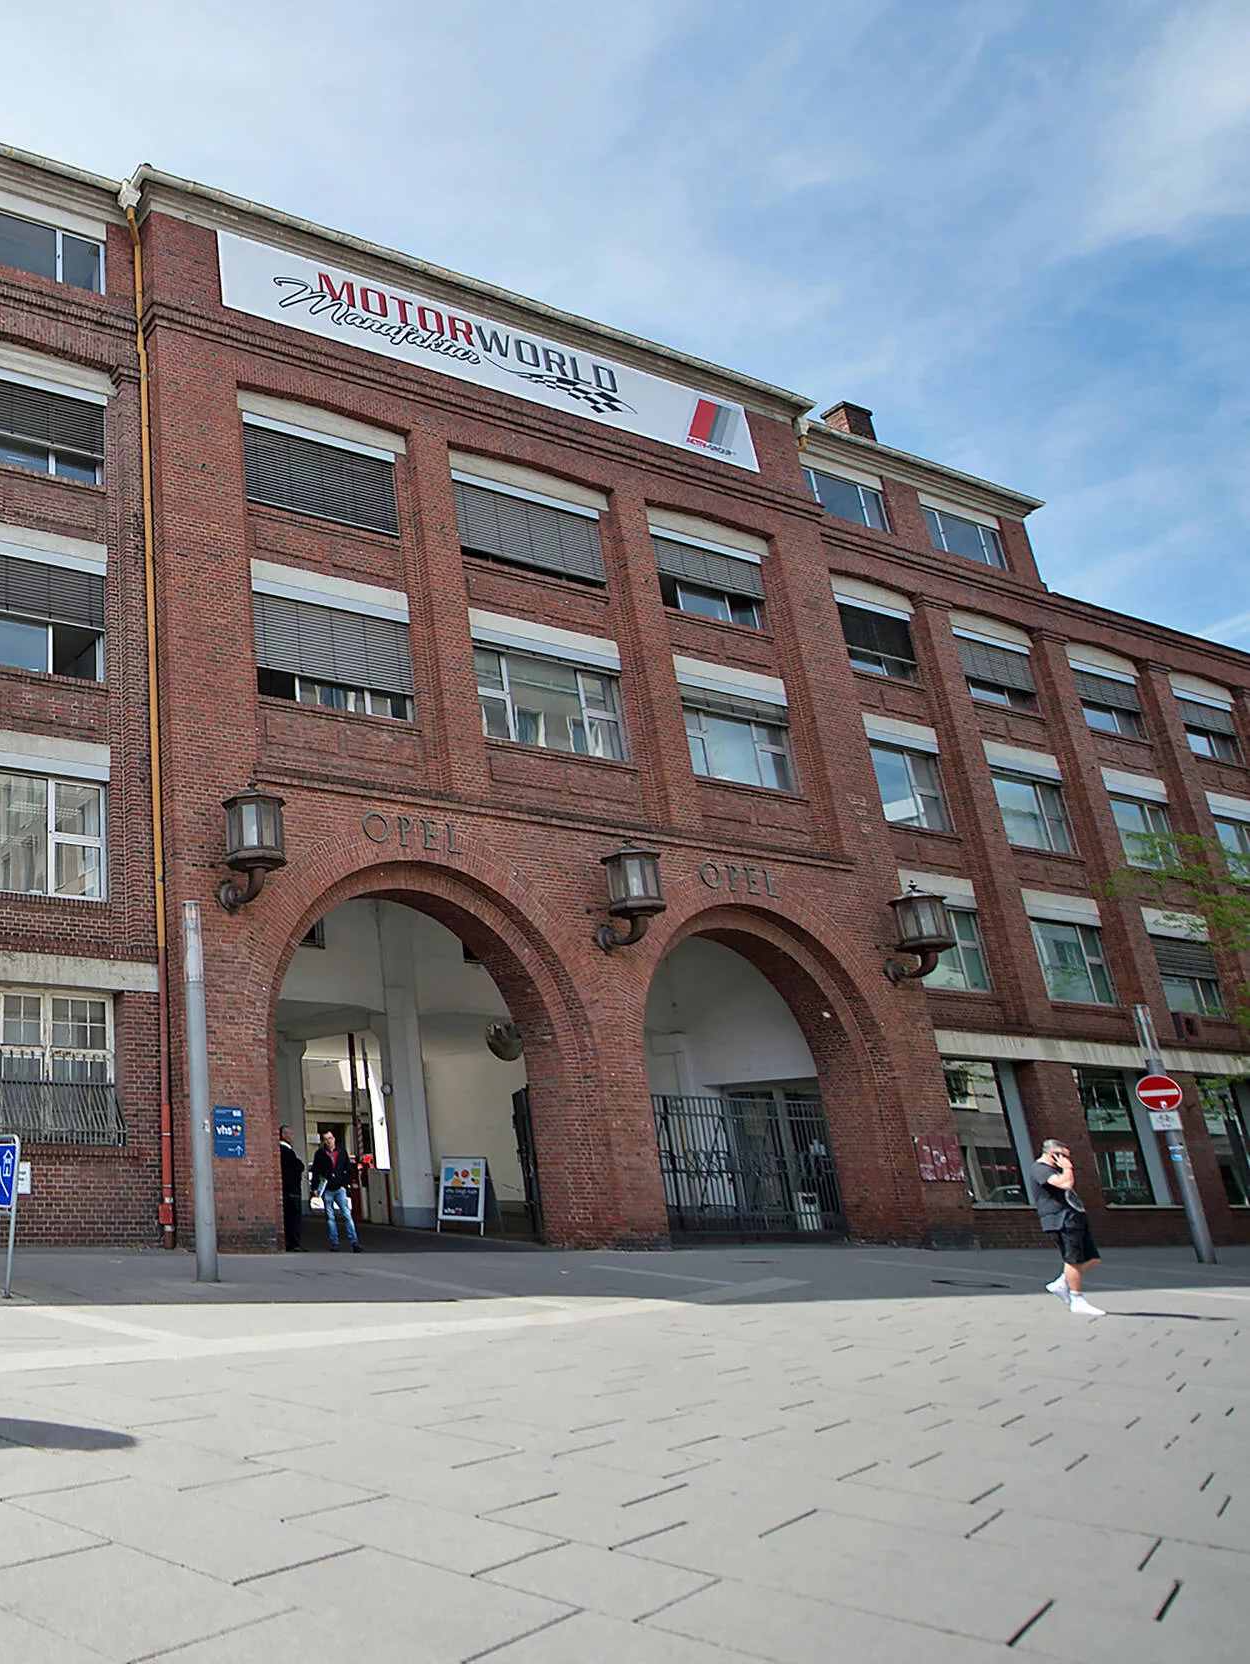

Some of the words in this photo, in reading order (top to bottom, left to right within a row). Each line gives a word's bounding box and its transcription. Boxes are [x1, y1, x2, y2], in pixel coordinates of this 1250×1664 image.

[273, 276, 481, 365] Manufaktur
[318, 271, 618, 393] MOTORWORLD
[362, 811, 465, 854] OPEL
[699, 861, 782, 897] OPEL
[215, 1125, 233, 1136] vhs
